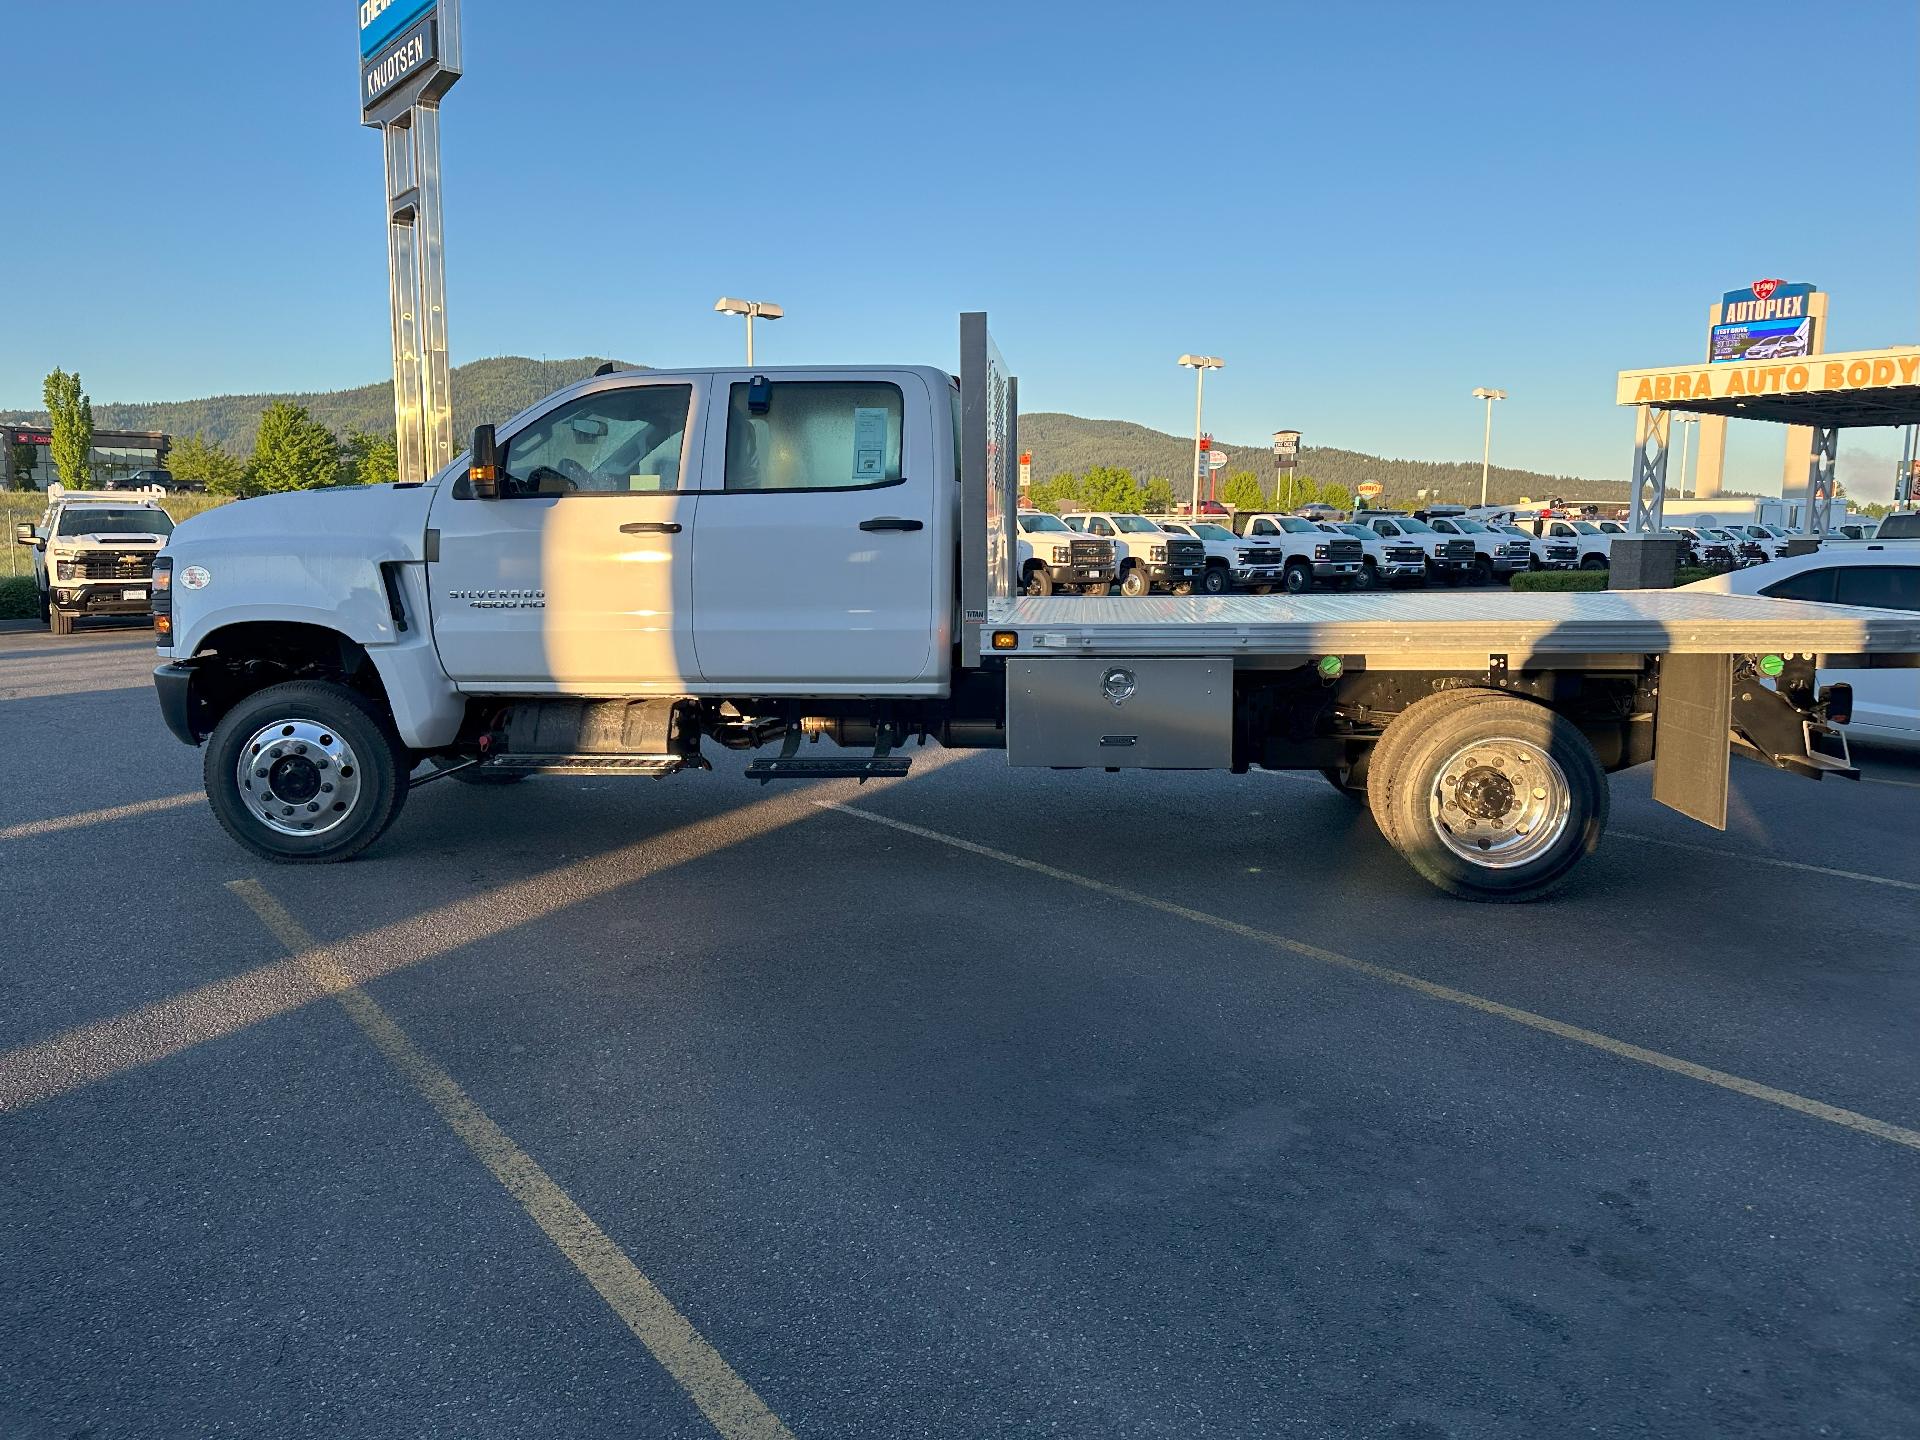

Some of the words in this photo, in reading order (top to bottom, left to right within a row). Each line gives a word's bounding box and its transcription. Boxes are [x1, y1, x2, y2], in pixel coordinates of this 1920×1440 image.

[367, 33, 423, 98] KNUDTSEN
[1726, 296, 1802, 323] AUTOPLEX
[1634, 373, 1712, 401] ABRA
[1724, 366, 1809, 396] AUTO
[1823, 357, 1920, 389] BODY
[449, 589, 545, 599] SILVERADO
[469, 600, 517, 609] 4500
[520, 599, 545, 608] HD
